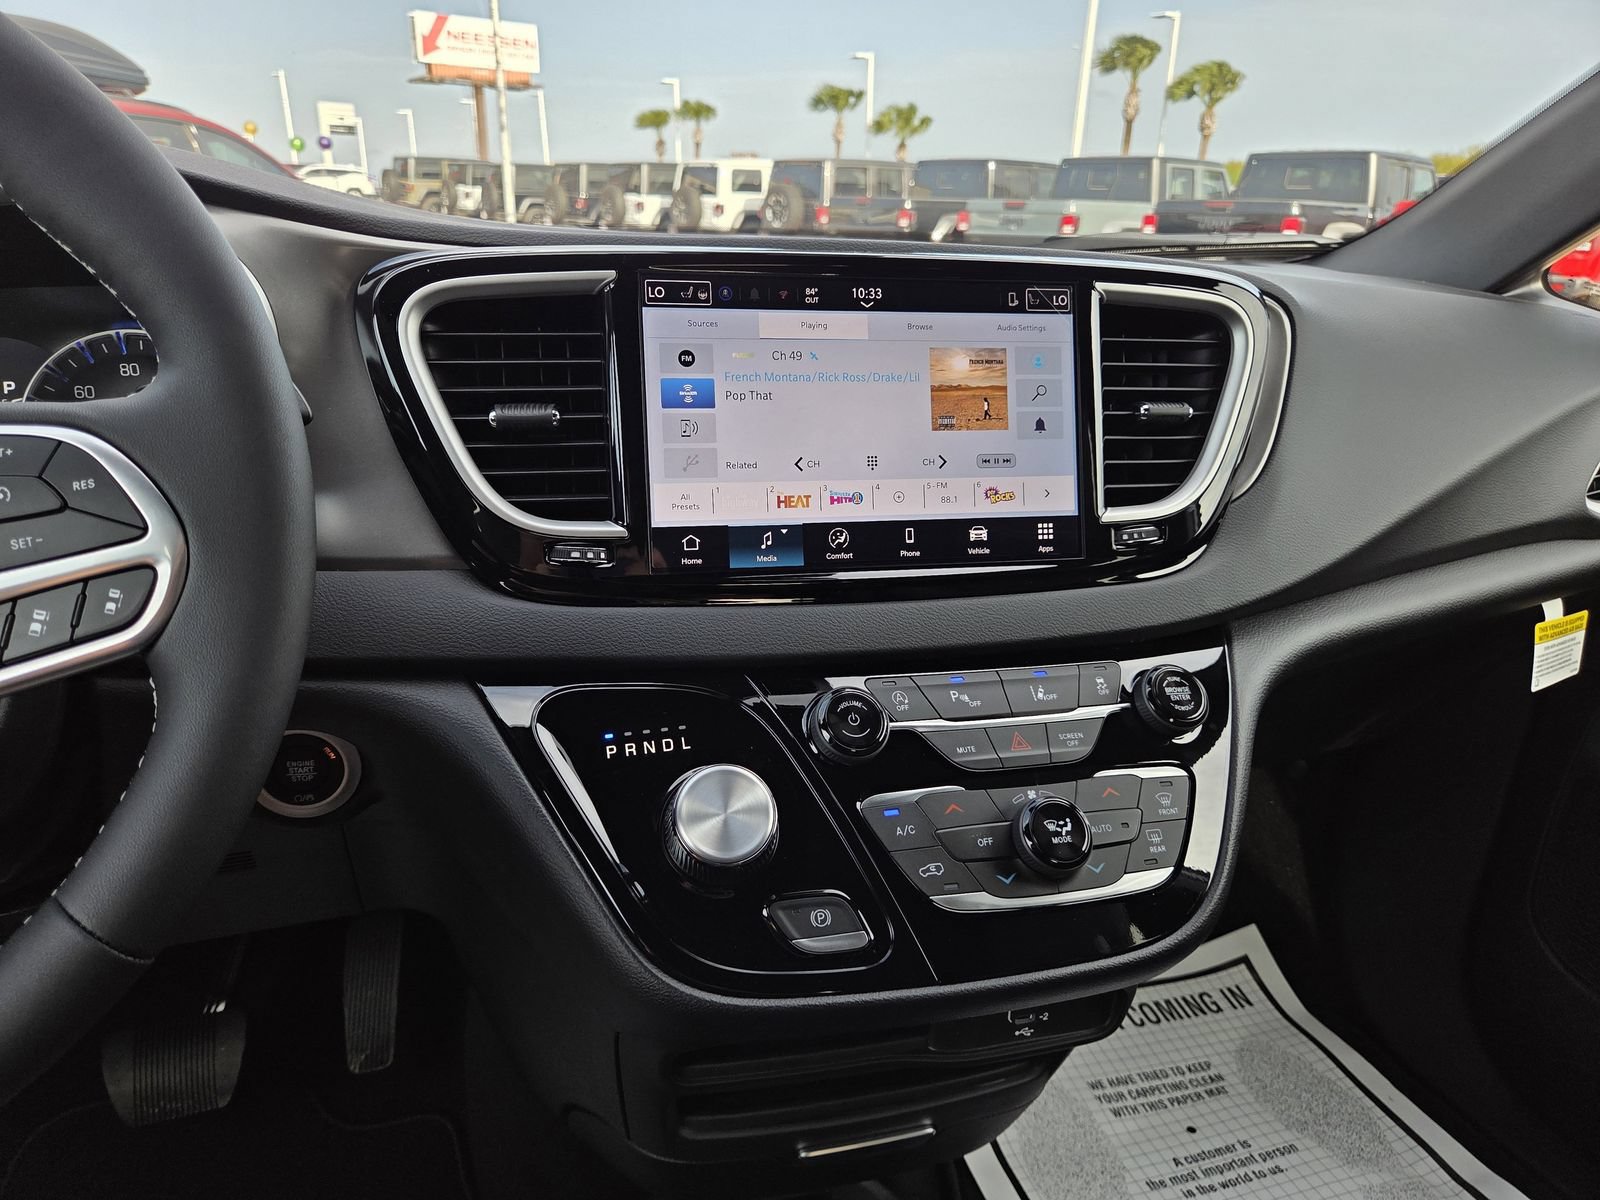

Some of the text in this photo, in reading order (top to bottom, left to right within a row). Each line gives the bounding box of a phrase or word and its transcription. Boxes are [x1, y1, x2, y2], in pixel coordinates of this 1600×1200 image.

[648, 286, 665, 298] LO
[805, 287, 819, 295] 84°
[852, 287, 882, 299] 10:33
[805, 296, 819, 304] OUT
[1053, 295, 1067, 306] LO
[687, 319, 719, 328] Sources
[800, 321, 828, 331] Playing
[907, 323, 933, 331] Browse
[997, 324, 1046, 333] Audio Settings
[771, 350, 803, 361] Ch 49
[119, 363, 140, 376] 80
[724, 371, 920, 383] French Montana/Rick Ross/Drake/Lil
[74, 385, 95, 399] 60
[725, 390, 773, 402] Pop That
[726, 460, 758, 470] Related
[806, 460, 820, 468] CH
[922, 458, 935, 466] CH
[72, 478, 96, 492] RES
[680, 493, 690, 501] All
[776, 494, 812, 509] HEAT
[671, 503, 700, 511] Presets
[900, 549, 920, 557] Phone
[967, 547, 990, 555] Vehicle
[1038, 545, 1054, 553] Apps
[756, 554, 778, 563] Media
[826, 551, 853, 560] Comfort
[681, 557, 703, 566] Home
[1165, 686, 1191, 694] BROWSE
[839, 700, 863, 709] VOLUME
[968, 700, 982, 708] OFF
[1058, 732, 1084, 740] SCREEN
[956, 745, 976, 754] MUTE
[286, 759, 316, 768] ENGINE
[1158, 807, 1179, 816] FRONT
[896, 825, 916, 837] A/C
[1091, 824, 1112, 833] AUTO
[977, 837, 994, 847] OFF
[1051, 836, 1073, 844] MODE
[1149, 845, 1167, 853] REAR
[1125, 983, 1254, 1028] COMING IN
[1087, 1060, 1212, 1091] WE HAVE TRIED TO KEEP
[1095, 1071, 1226, 1104] YOUR CARPETING CLEAN
[1109, 1085, 1229, 1118] WITH THIS PAPER MAT
[1172, 1138, 1252, 1168] A customer is
[1145, 1142, 1299, 1191] the most important person
[1181, 1163, 1289, 1200] in the world to us.
